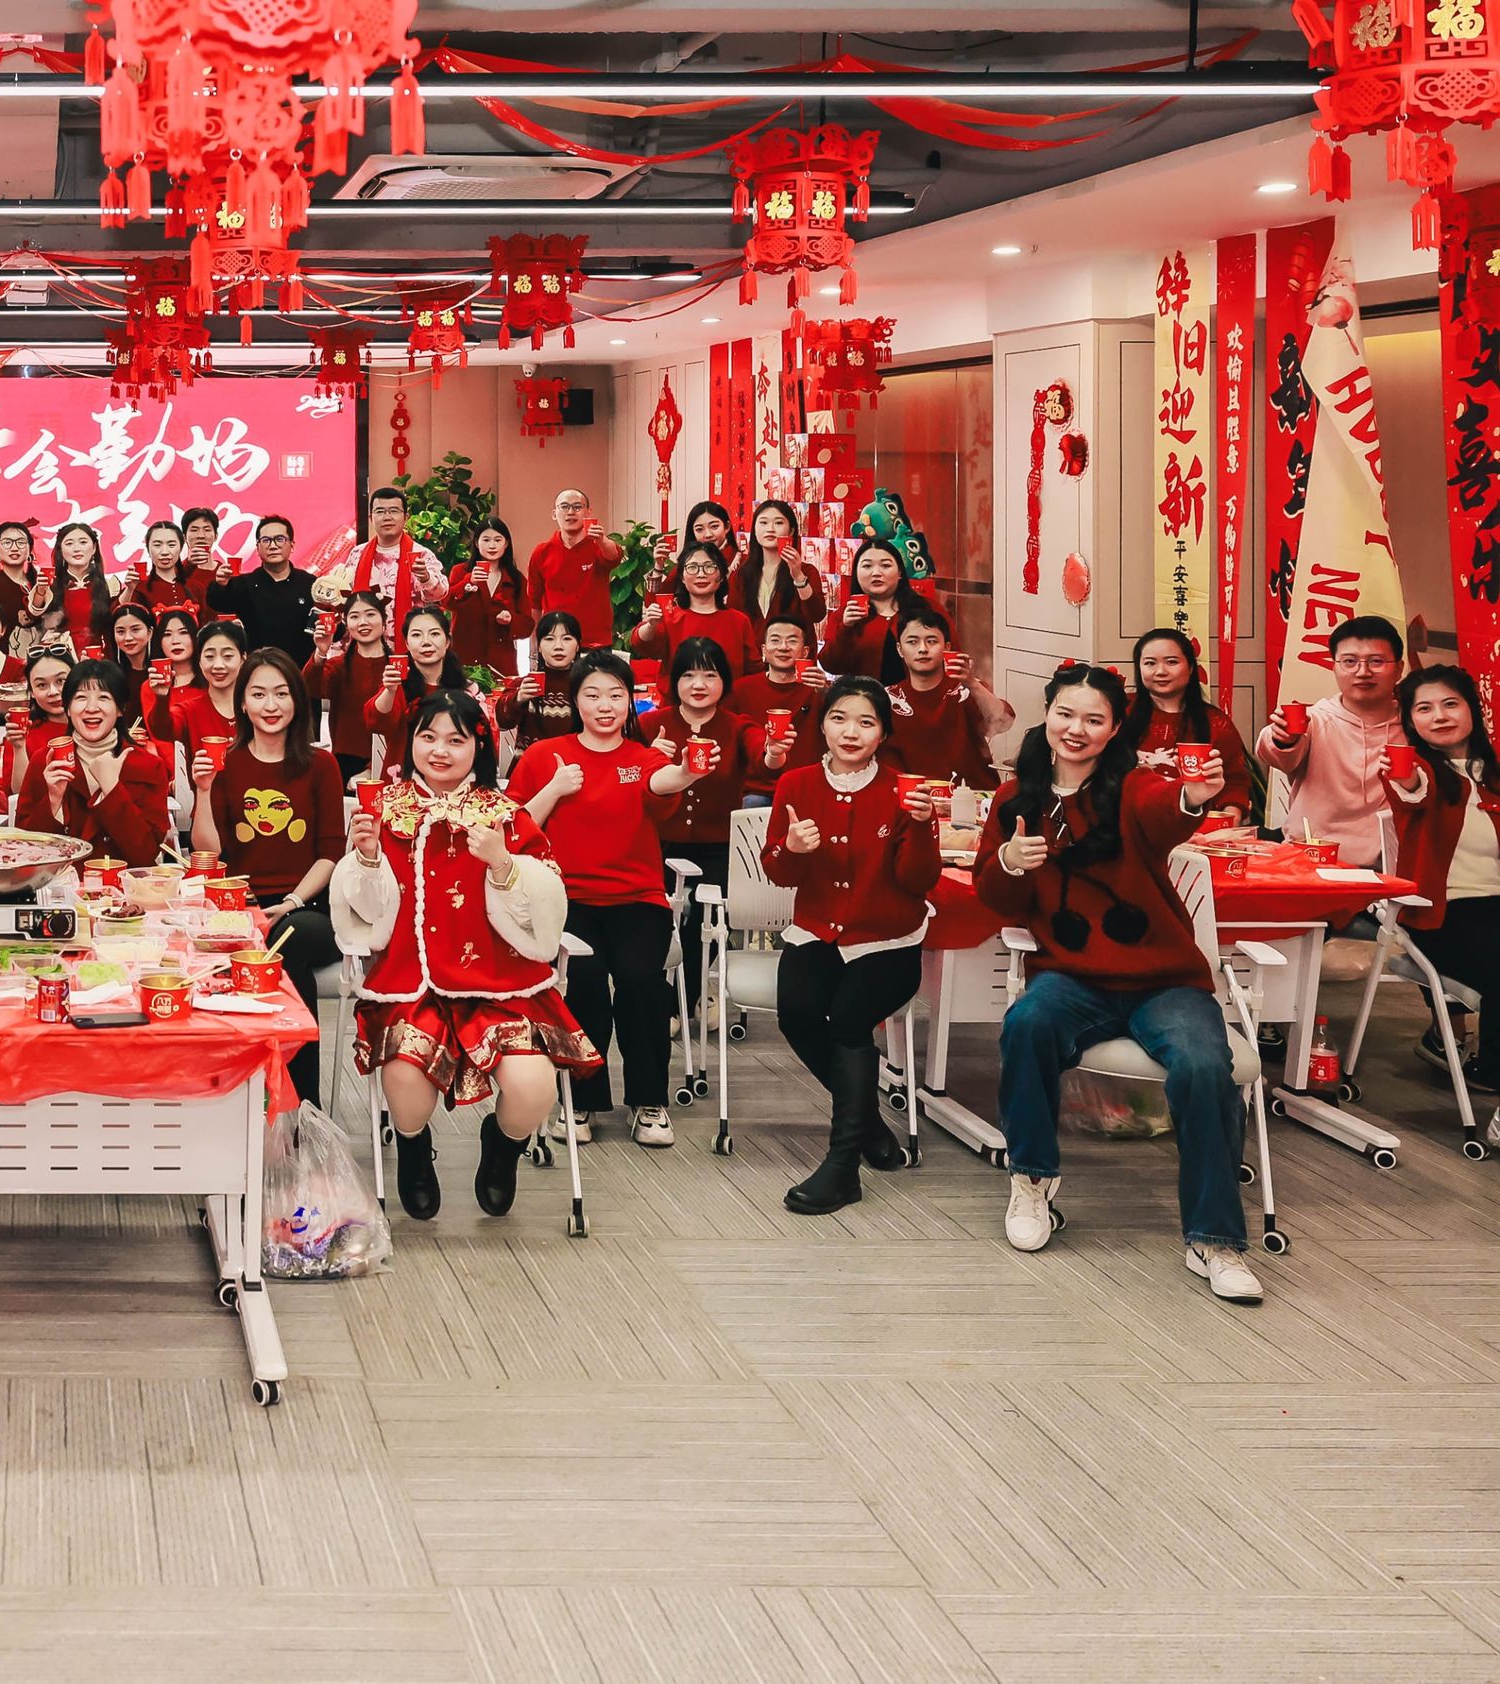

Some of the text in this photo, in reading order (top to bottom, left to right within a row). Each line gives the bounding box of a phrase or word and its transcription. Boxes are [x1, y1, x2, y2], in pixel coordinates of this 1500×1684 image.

[765, 191, 794, 219] 福
[812, 191, 836, 219] 福
[513, 274, 532, 294] 福
[543, 274, 561, 294] 福
[155, 297, 176, 317] 福
[417, 311, 433, 327] 福
[1156, 250, 1207, 545] 辞旧迎新
[1225, 322, 1244, 474] 欢愉且胜意
